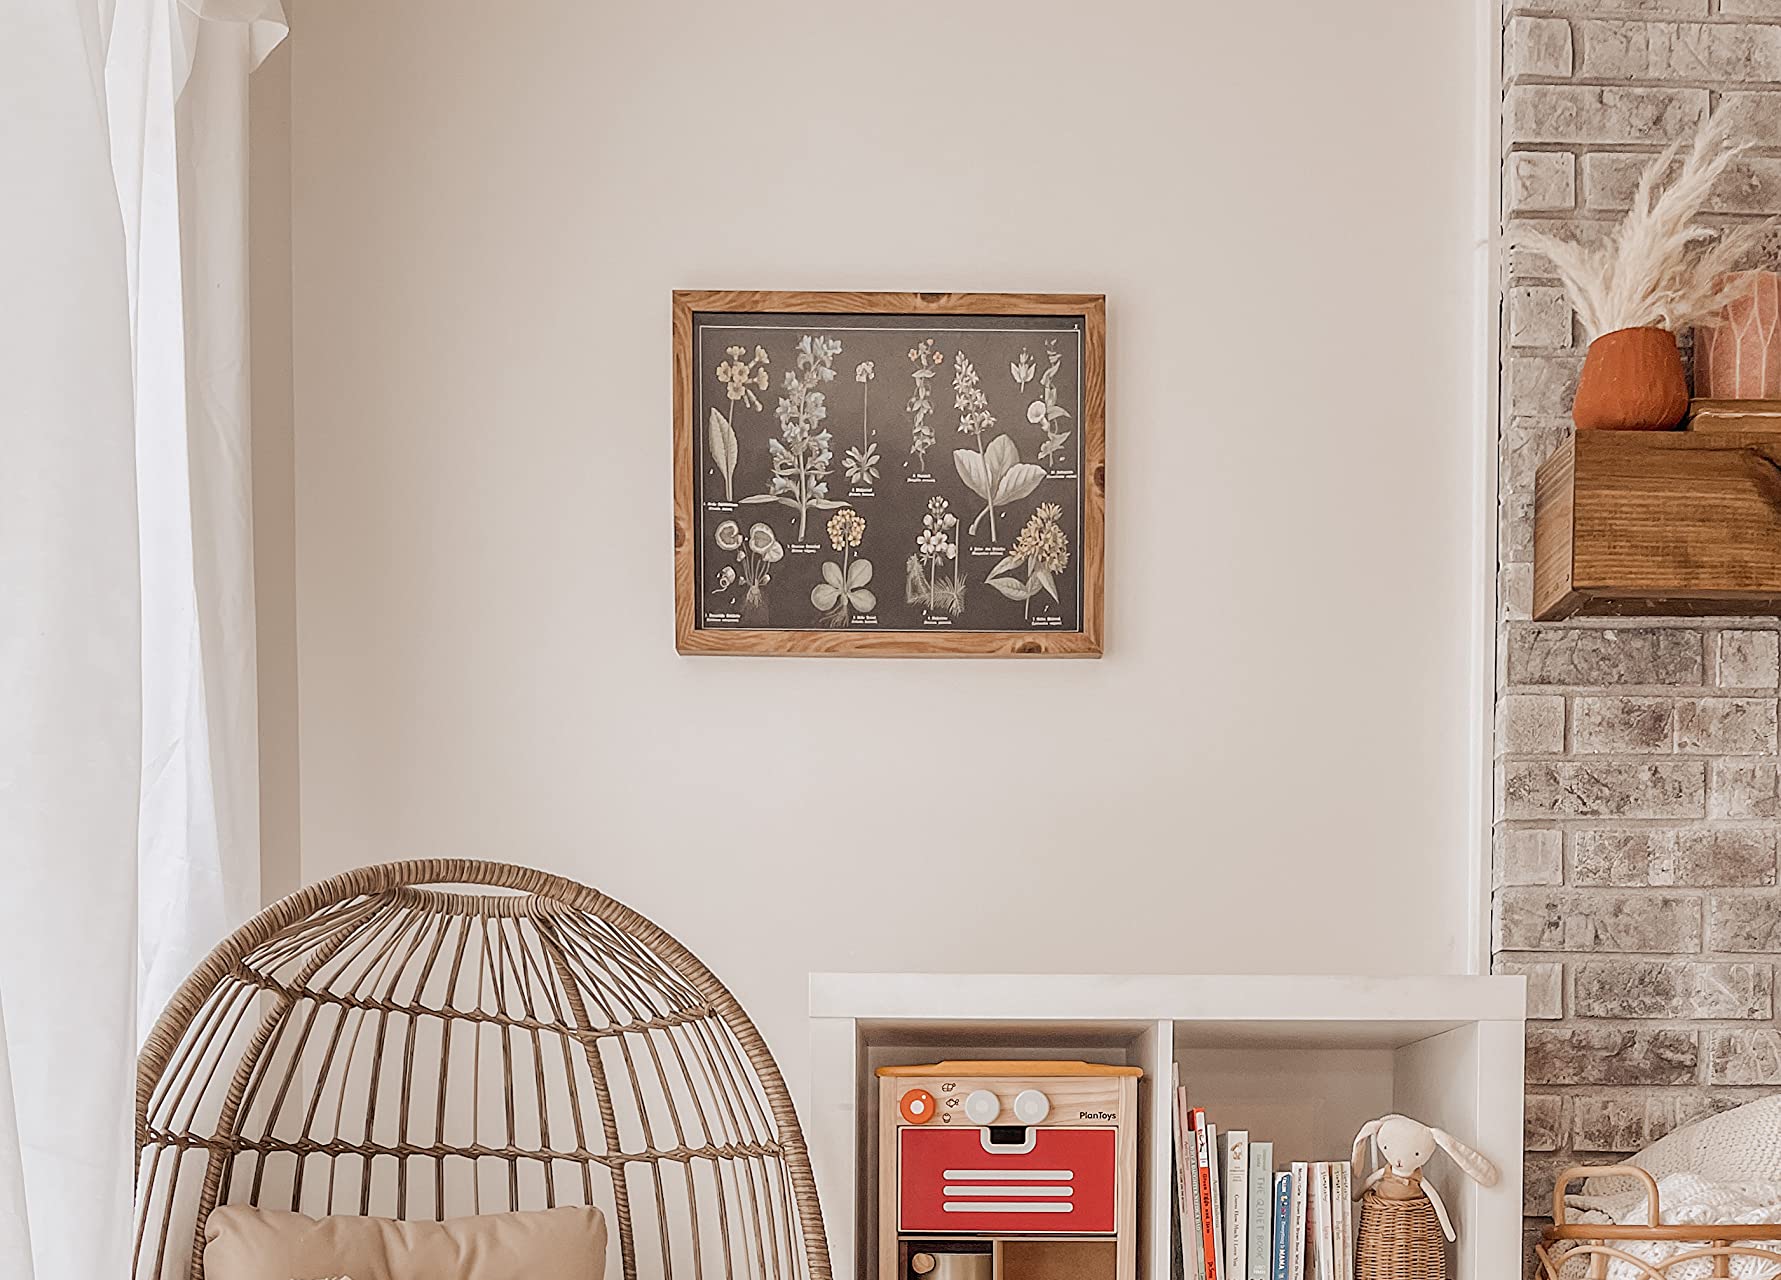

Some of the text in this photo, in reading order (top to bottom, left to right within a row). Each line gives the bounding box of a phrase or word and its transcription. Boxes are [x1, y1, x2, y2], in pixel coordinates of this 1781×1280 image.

[1079, 1111, 1117, 1121] PlanToys
[1256, 1177, 1265, 1195] THE
[1255, 1198, 1264, 1230] QUIET
[1255, 1234, 1264, 1260] BOOK
